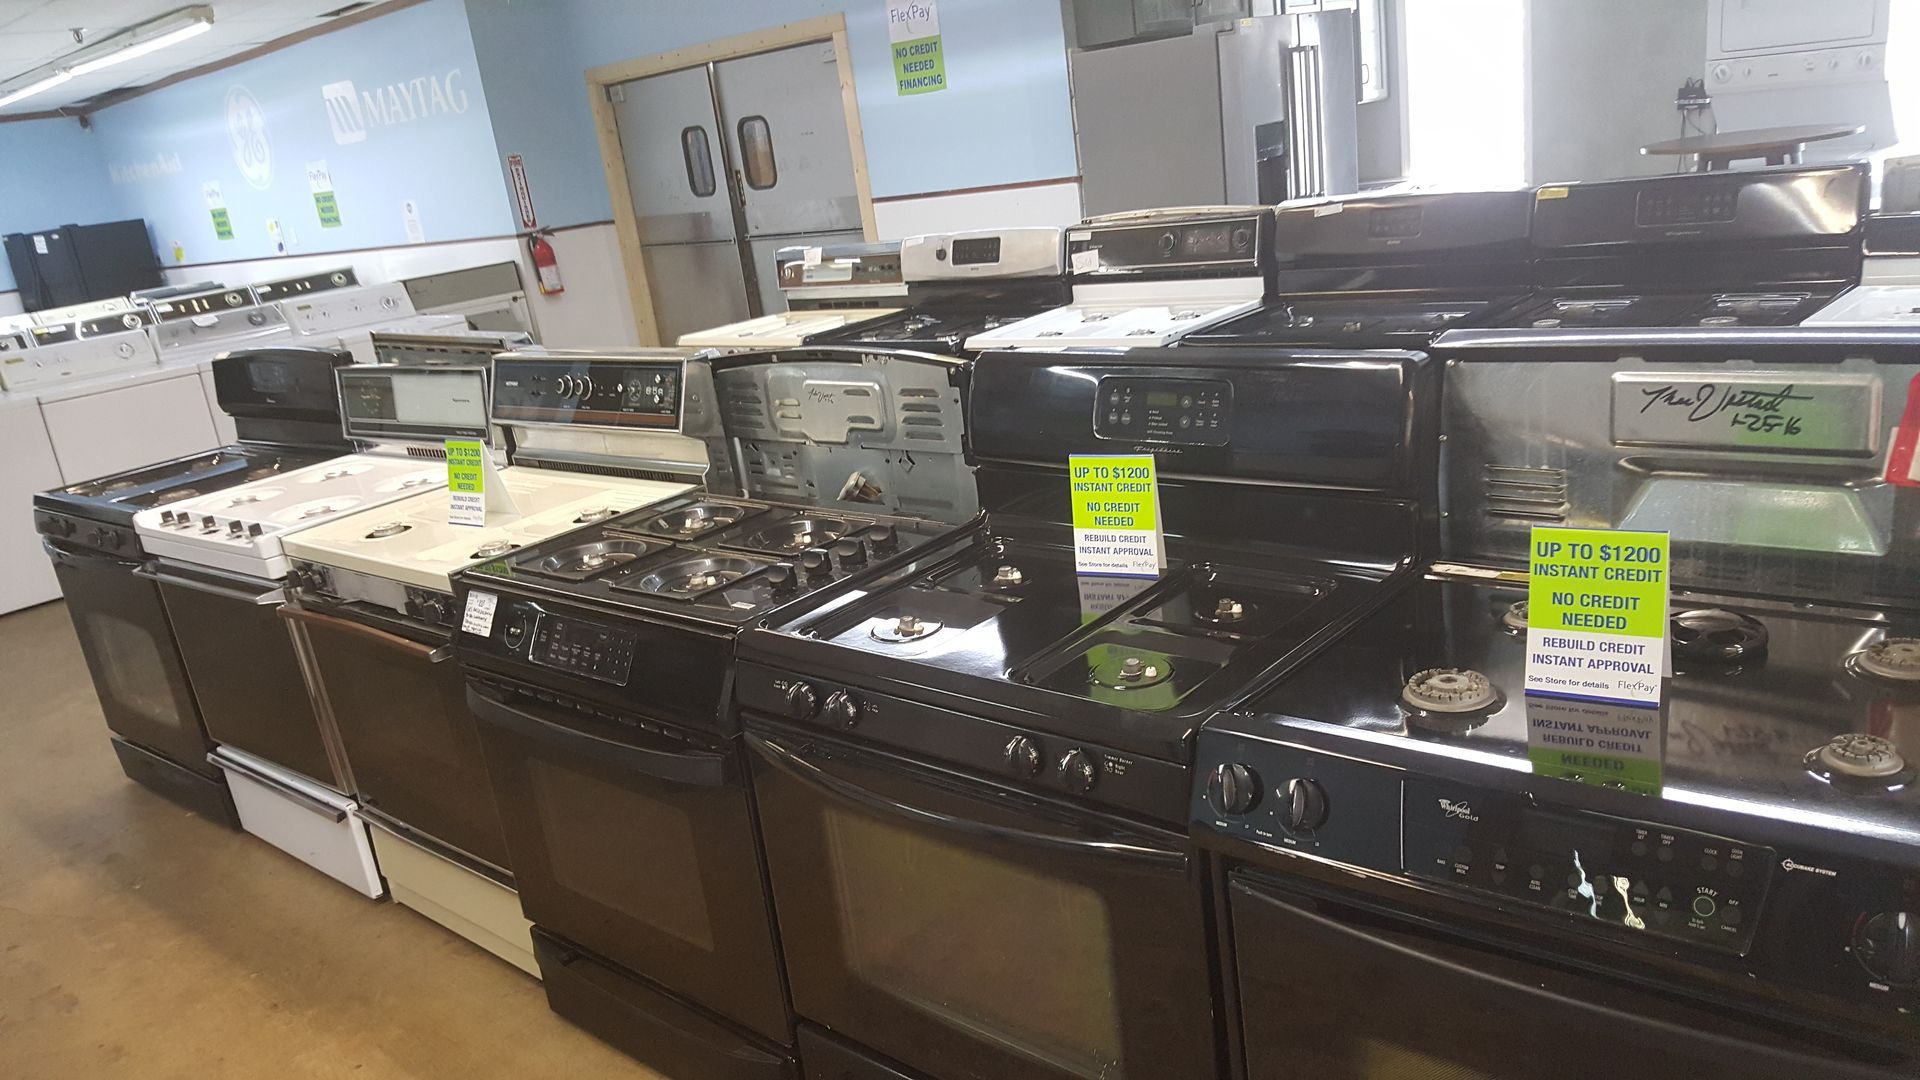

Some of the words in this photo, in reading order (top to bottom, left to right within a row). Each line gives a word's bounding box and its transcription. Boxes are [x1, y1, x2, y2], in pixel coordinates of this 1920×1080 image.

[890, 4, 933, 24] FlexPay
[895, 47, 908, 59] NO
[909, 41, 938, 57] CREDIT
[903, 58, 935, 74] NEEDED
[899, 73, 943, 91] FINANCING
[362, 68, 469, 128] MAYTAG
[456, 448, 463, 457] TO
[464, 448, 481, 457] $1200
[1074, 467, 1090, 479] UP
[1093, 467, 1109, 479] TO
[1113, 466, 1150, 480] $1200
[1074, 482, 1114, 492] INSTANT
[1117, 483, 1152, 493] CREDIT
[1087, 502, 1101, 512] NO
[1104, 502, 1141, 513] CREDIT
[1094, 516, 1134, 527] NEEDED
[1084, 534, 1117, 543] REBUILD
[1119, 535, 1147, 544] CREDIT
[1079, 546, 1112, 555] INSTANT
[1113, 547, 1154, 556] APPROVAL
[1537, 541, 1562, 558] UP
[1568, 543, 1594, 560] TO
[1600, 543, 1661, 564] $1200
[1534, 563, 1599, 579] INSTANT
[1604, 566, 1664, 583] CREDIT
[1552, 591, 1575, 606] NO
[1580, 593, 1641, 611] CREDIT
[1562, 612, 1627, 630] NEEDED
[1542, 636, 1595, 651] REBUILD
[1599, 641, 1646, 656] CREDIT
[1532, 653, 1584, 668] INSTANT
[1587, 658, 1655, 675] APPROVAL
[1528, 674, 1543, 683] See
[1545, 676, 1567, 686] Store
[1568, 679, 1580, 687] for
[1582, 680, 1610, 690] details
[1617, 679, 1658, 695] FlexPay
[1438, 799, 1471, 816] Whirlpool
[1458, 812, 1479, 822] Gold
[1815, 868, 1837, 877] SYSTEM
[1696, 886, 1718, 898] START
[1728, 899, 1739, 907] OFF
